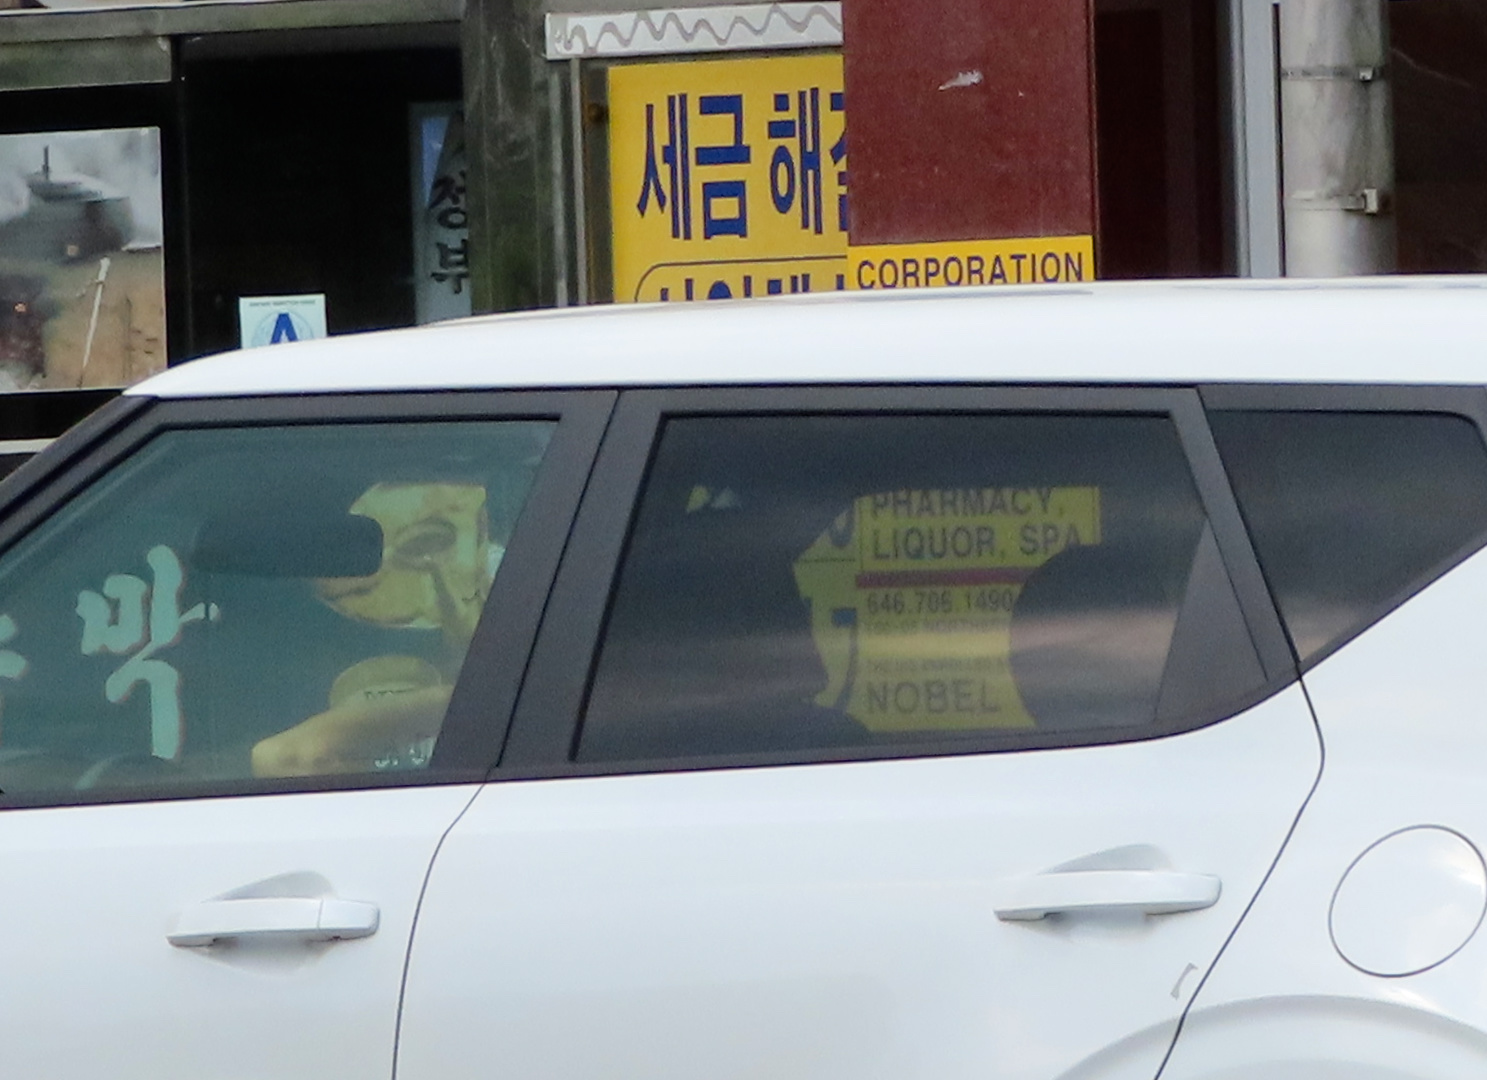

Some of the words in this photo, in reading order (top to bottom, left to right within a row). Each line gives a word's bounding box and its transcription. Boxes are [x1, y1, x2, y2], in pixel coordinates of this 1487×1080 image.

[636, 92, 752, 241] 세금
[767, 87, 848, 235] 해
[857, 251, 1084, 290] CORPORATION
[865, 680, 1001, 714] NOBEL
